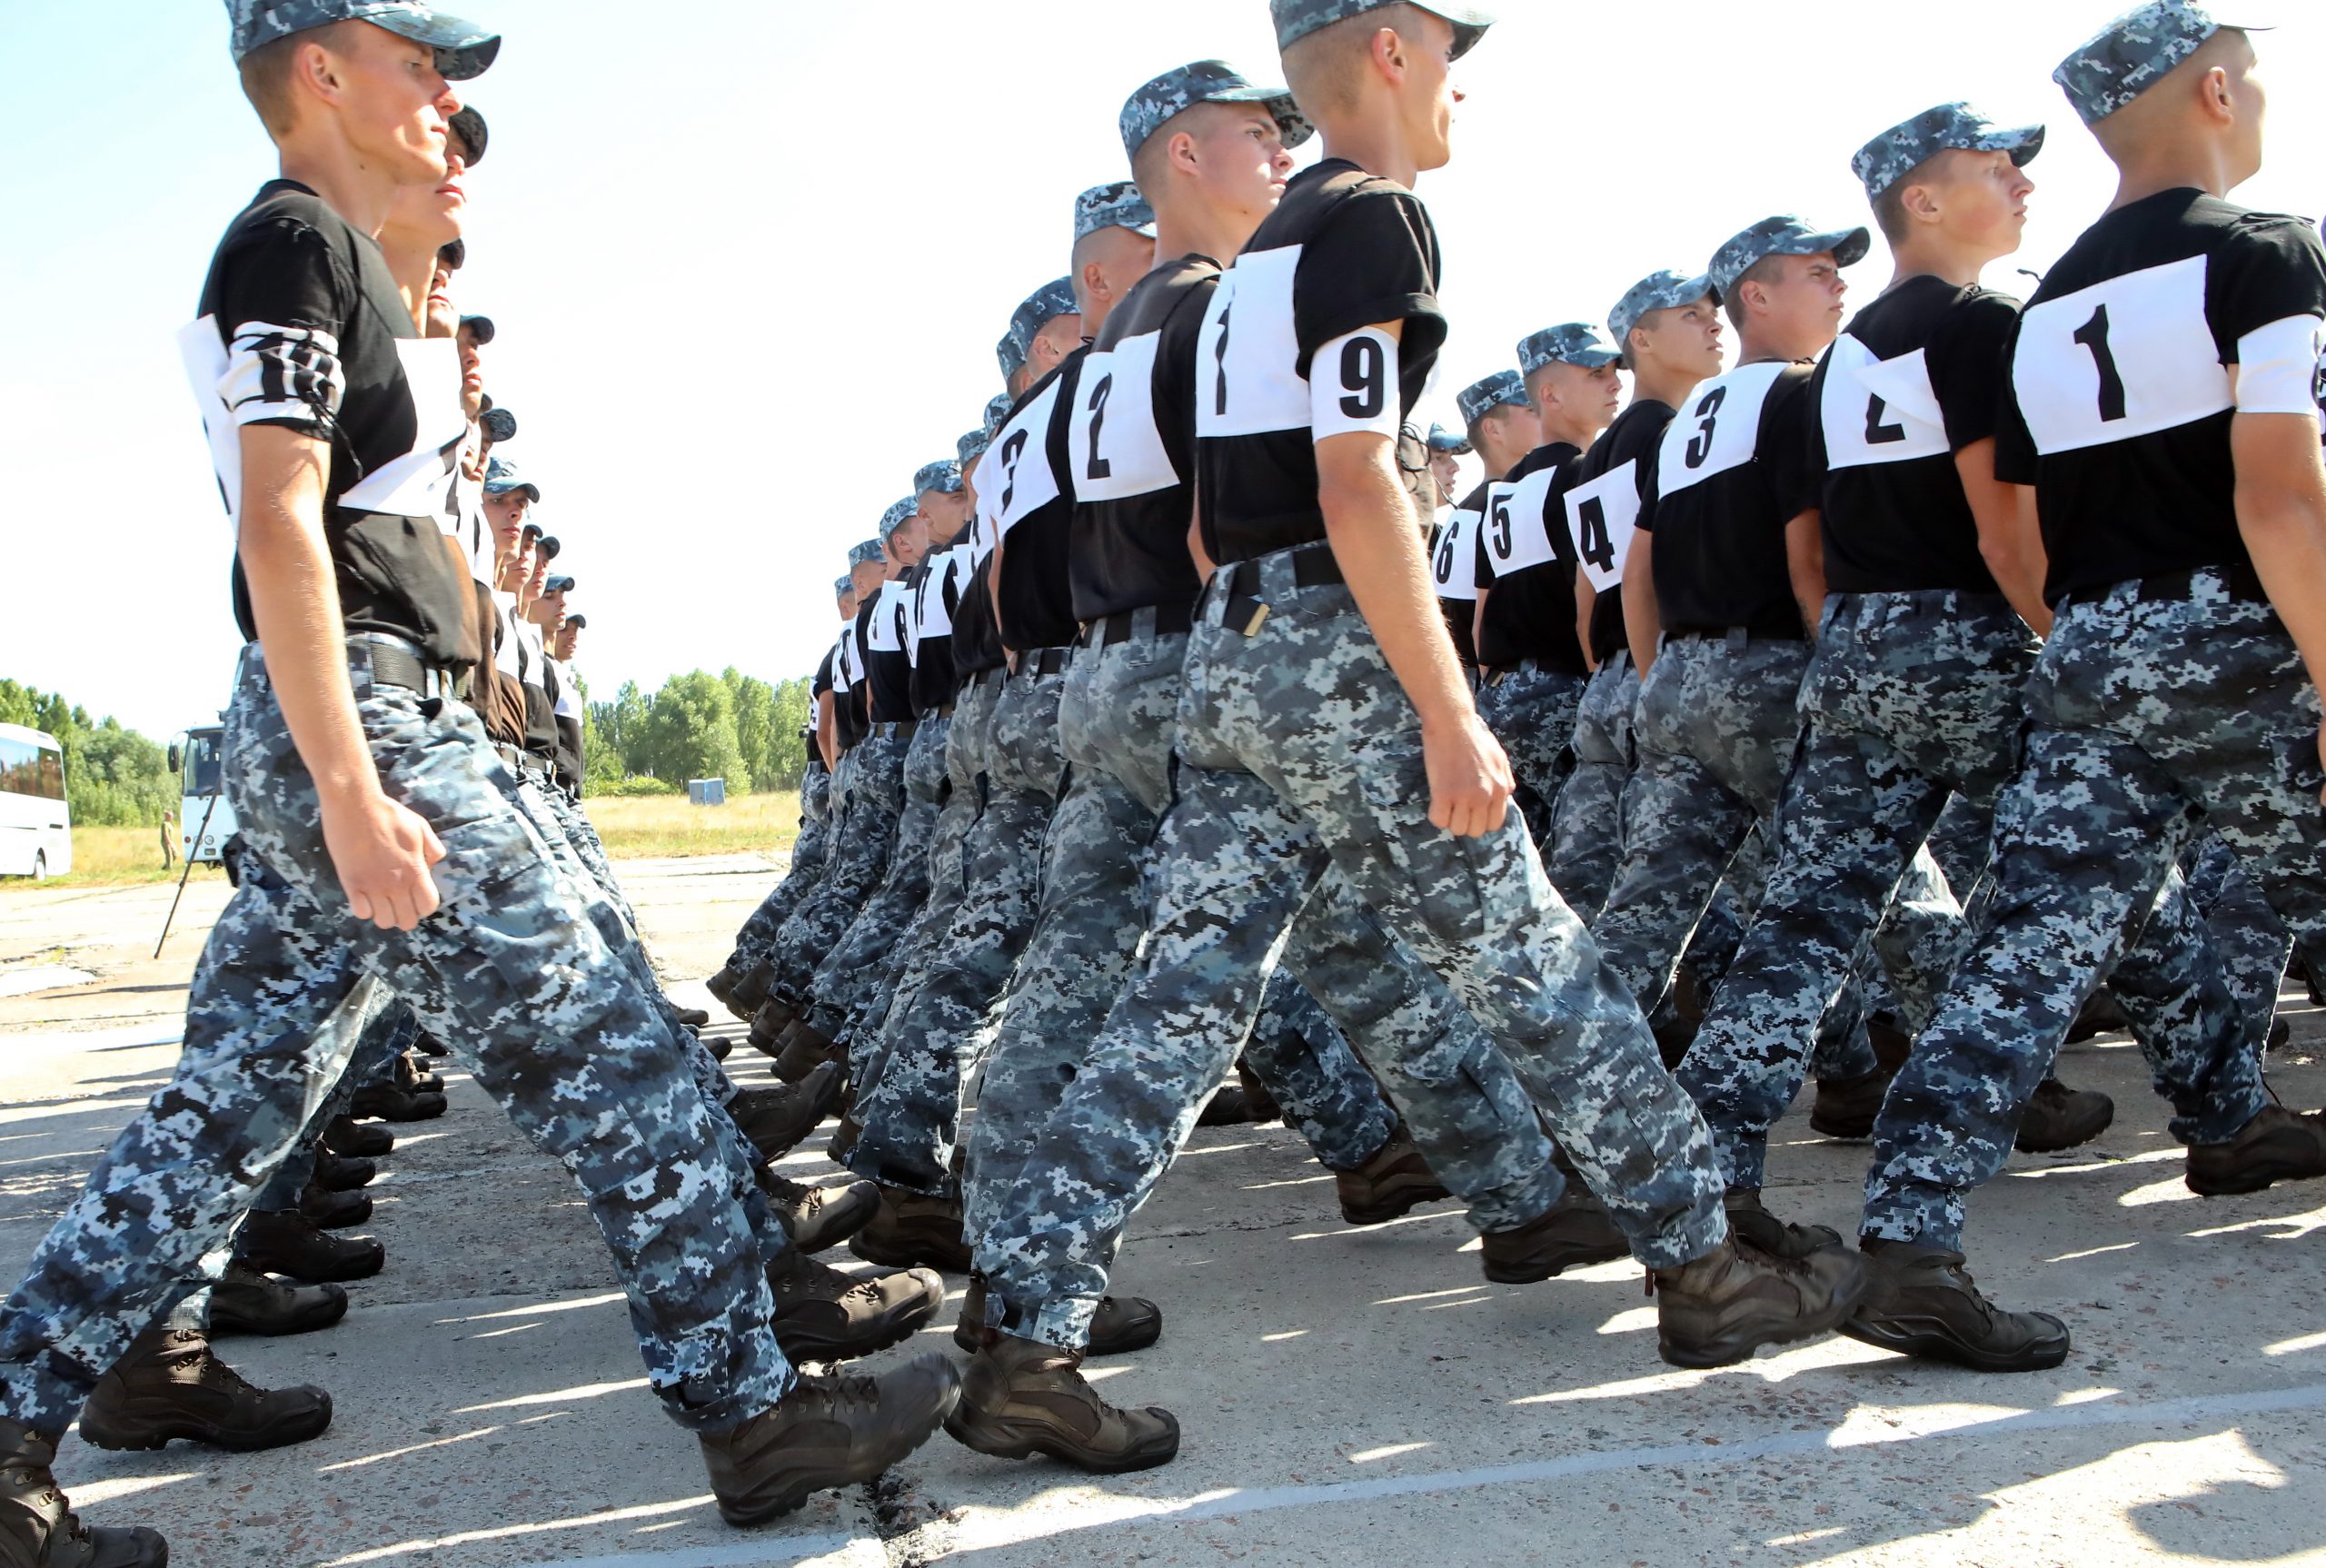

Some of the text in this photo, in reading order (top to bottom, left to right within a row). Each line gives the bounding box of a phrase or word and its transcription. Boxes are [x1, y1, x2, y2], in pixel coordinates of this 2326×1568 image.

[1339, 336, 1384, 419] 9
[2073, 303, 2126, 422] 1
[1087, 372, 1112, 480] 2
[1685, 385, 1726, 469] 3
[1436, 521, 1460, 584] 6
[1491, 492, 1516, 560] 5
[1578, 495, 1615, 573] 4
